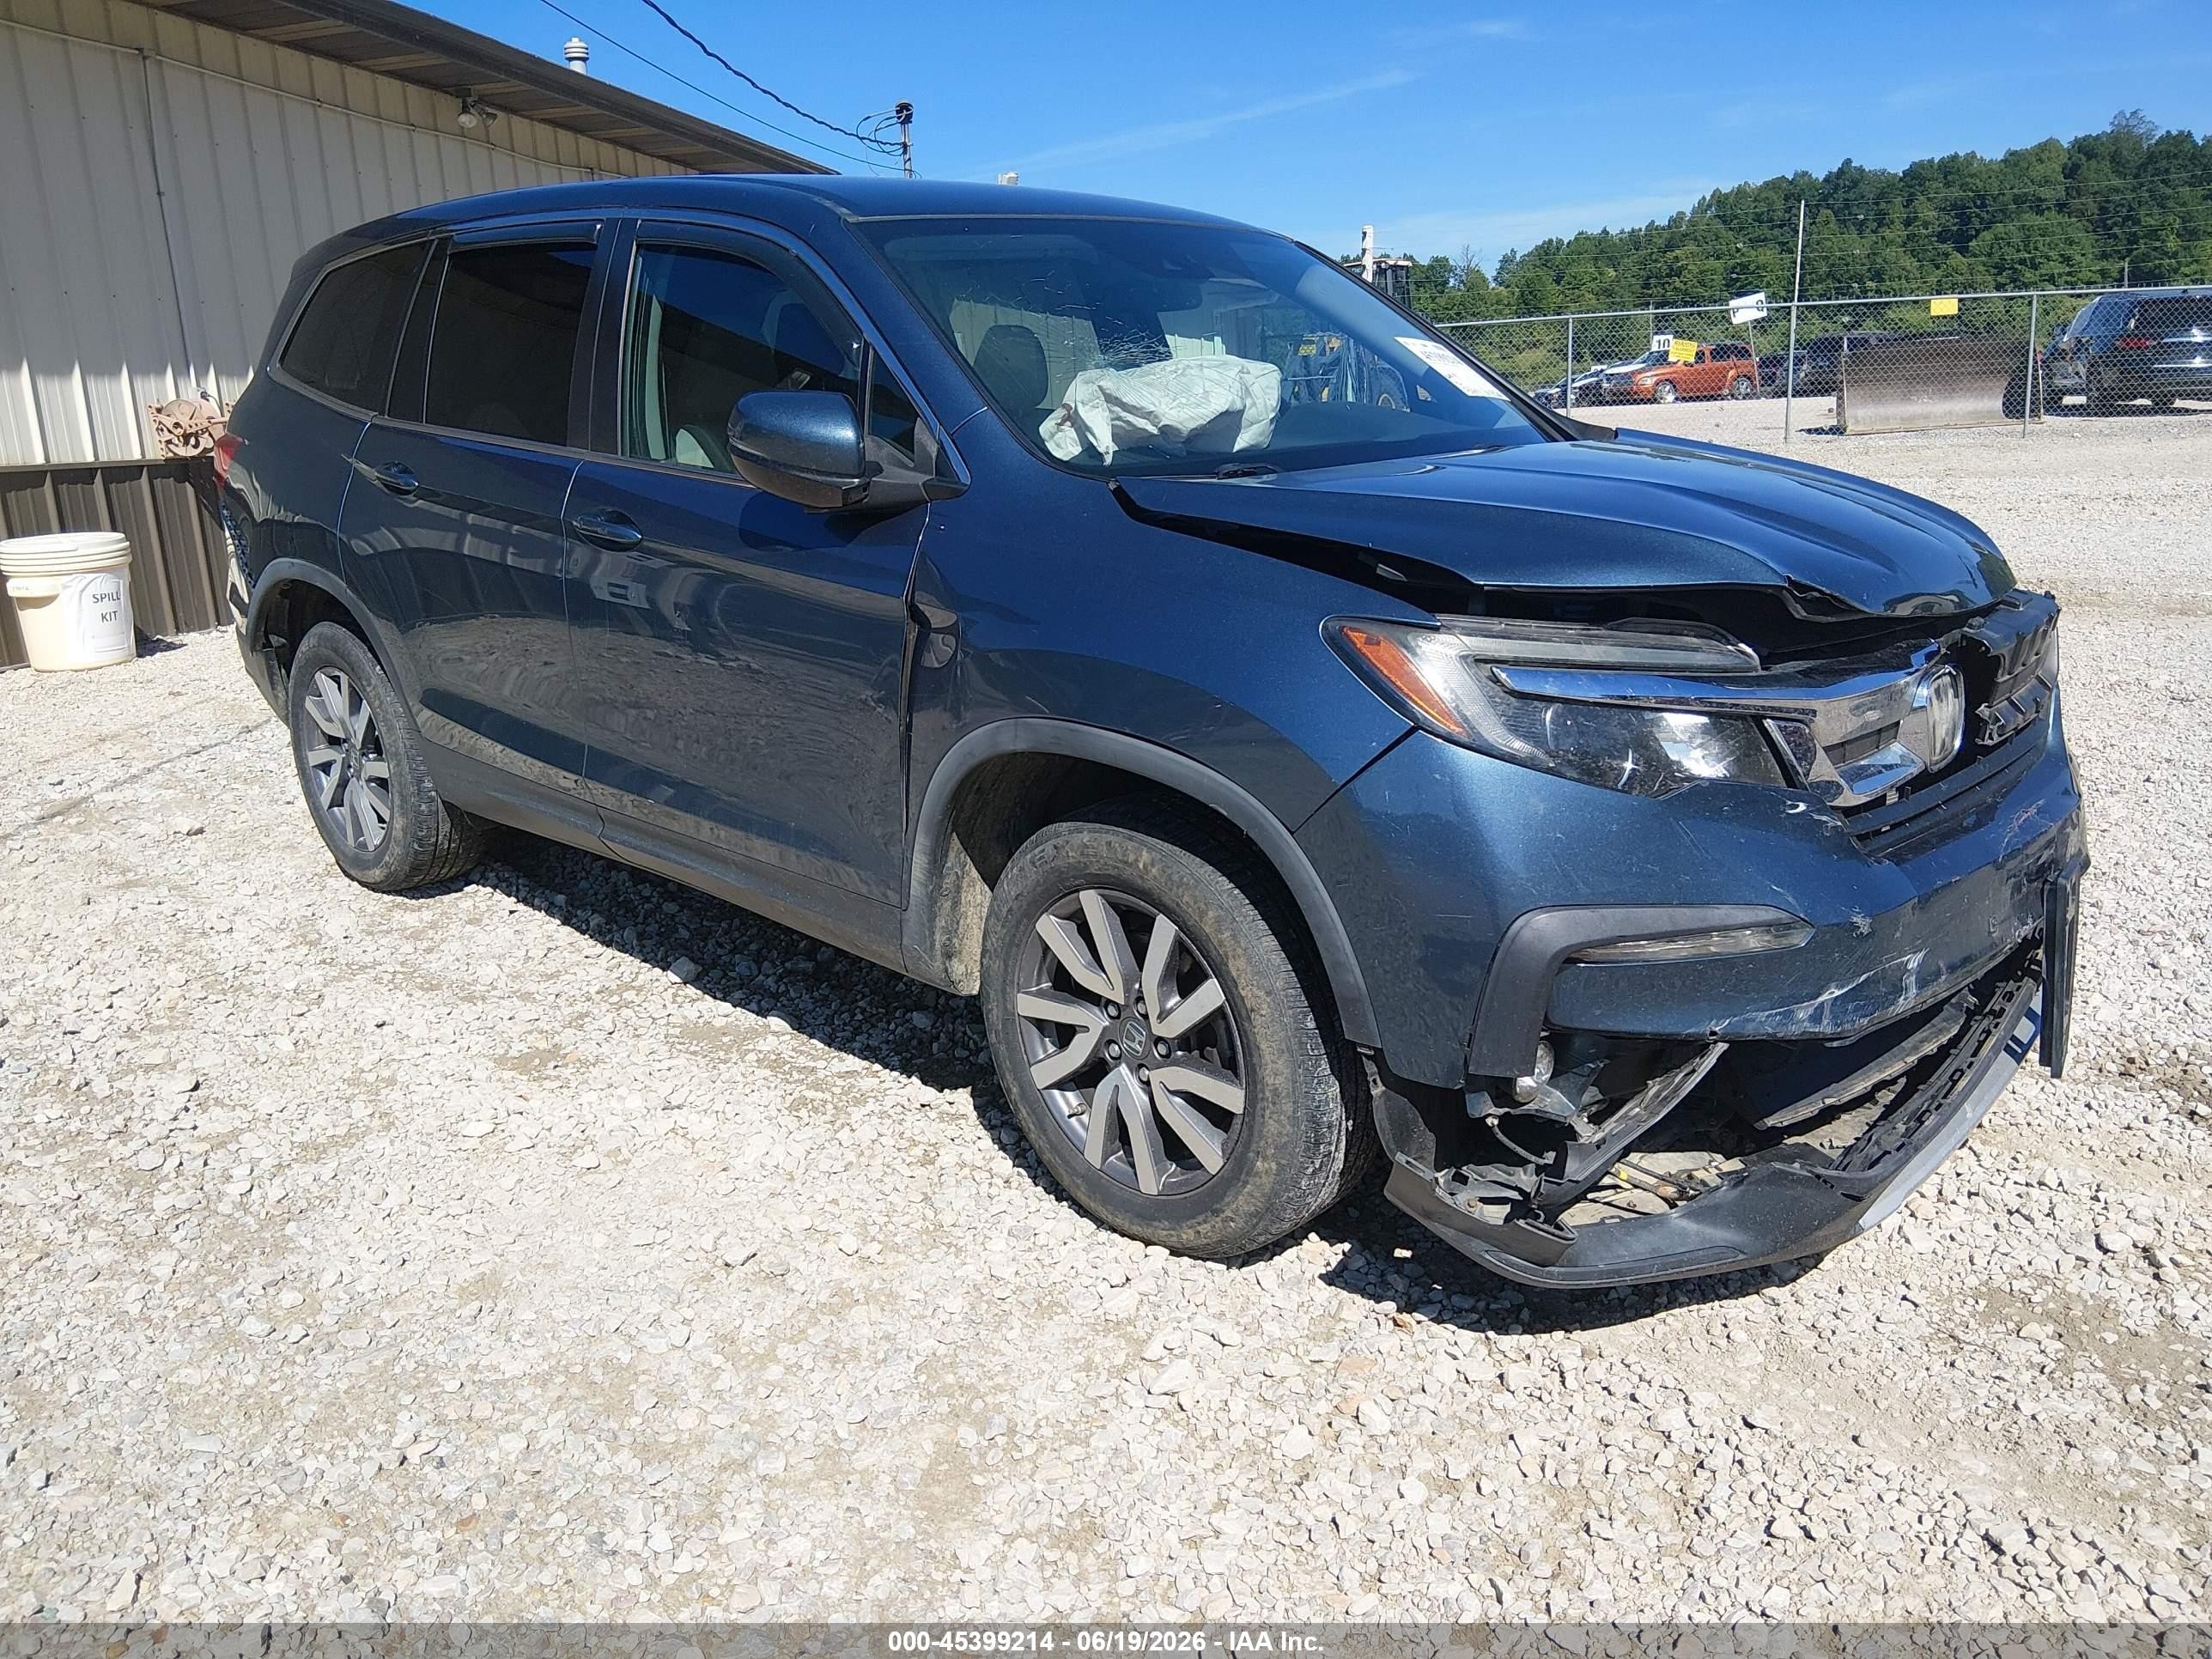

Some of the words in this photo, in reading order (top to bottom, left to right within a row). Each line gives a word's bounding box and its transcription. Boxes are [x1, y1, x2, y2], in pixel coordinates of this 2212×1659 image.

[1756, 299, 1765, 312] Q
[1656, 337, 1670, 349] 10
[92, 591, 121, 604] SPILL
[101, 611, 118, 623] KIT
